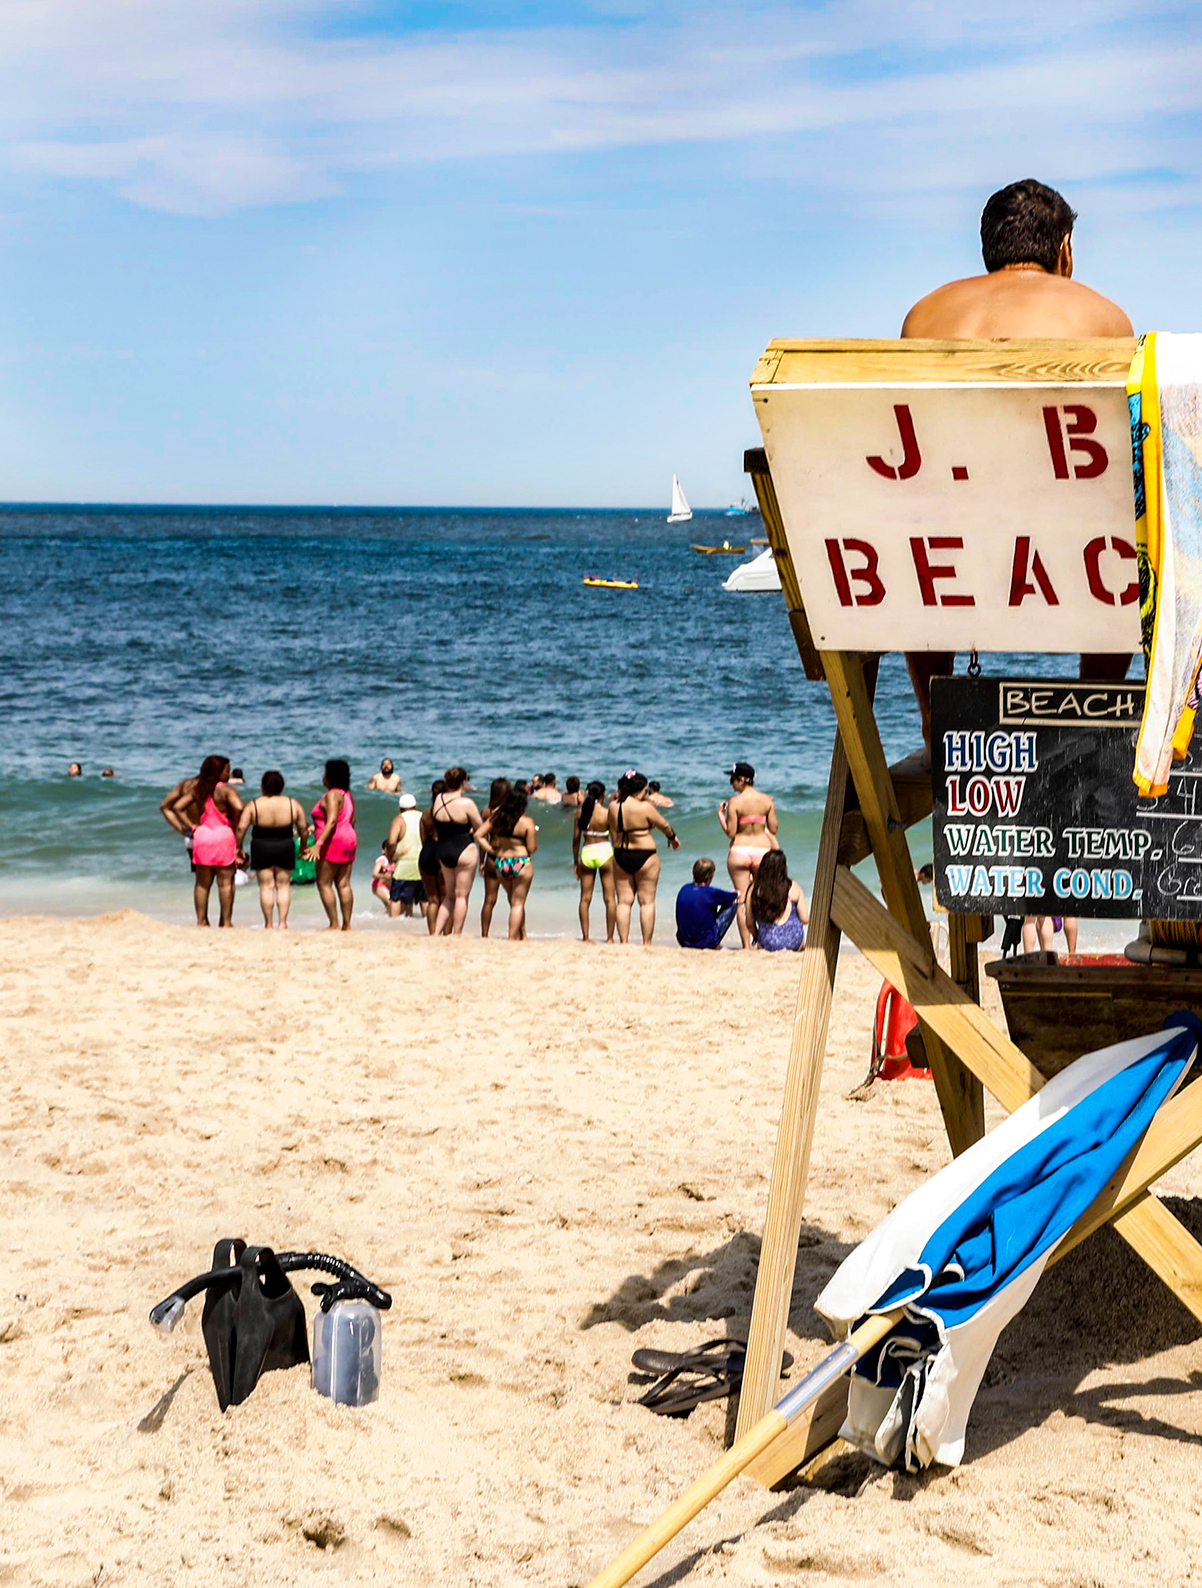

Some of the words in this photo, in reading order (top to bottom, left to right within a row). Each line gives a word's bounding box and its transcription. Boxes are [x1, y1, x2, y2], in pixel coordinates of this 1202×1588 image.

[865, 404, 969, 481] J.
[824, 535, 1140, 607] BEAC
[1005, 691, 1135, 718] BEACH
[943, 731, 1039, 773] HIGH
[945, 775, 1027, 818] LOW
[943, 823, 1056, 858] WATER
[1062, 827, 1163, 861] TEMP.
[945, 864, 1046, 899] WATER
[1053, 868, 1144, 900] COND.
